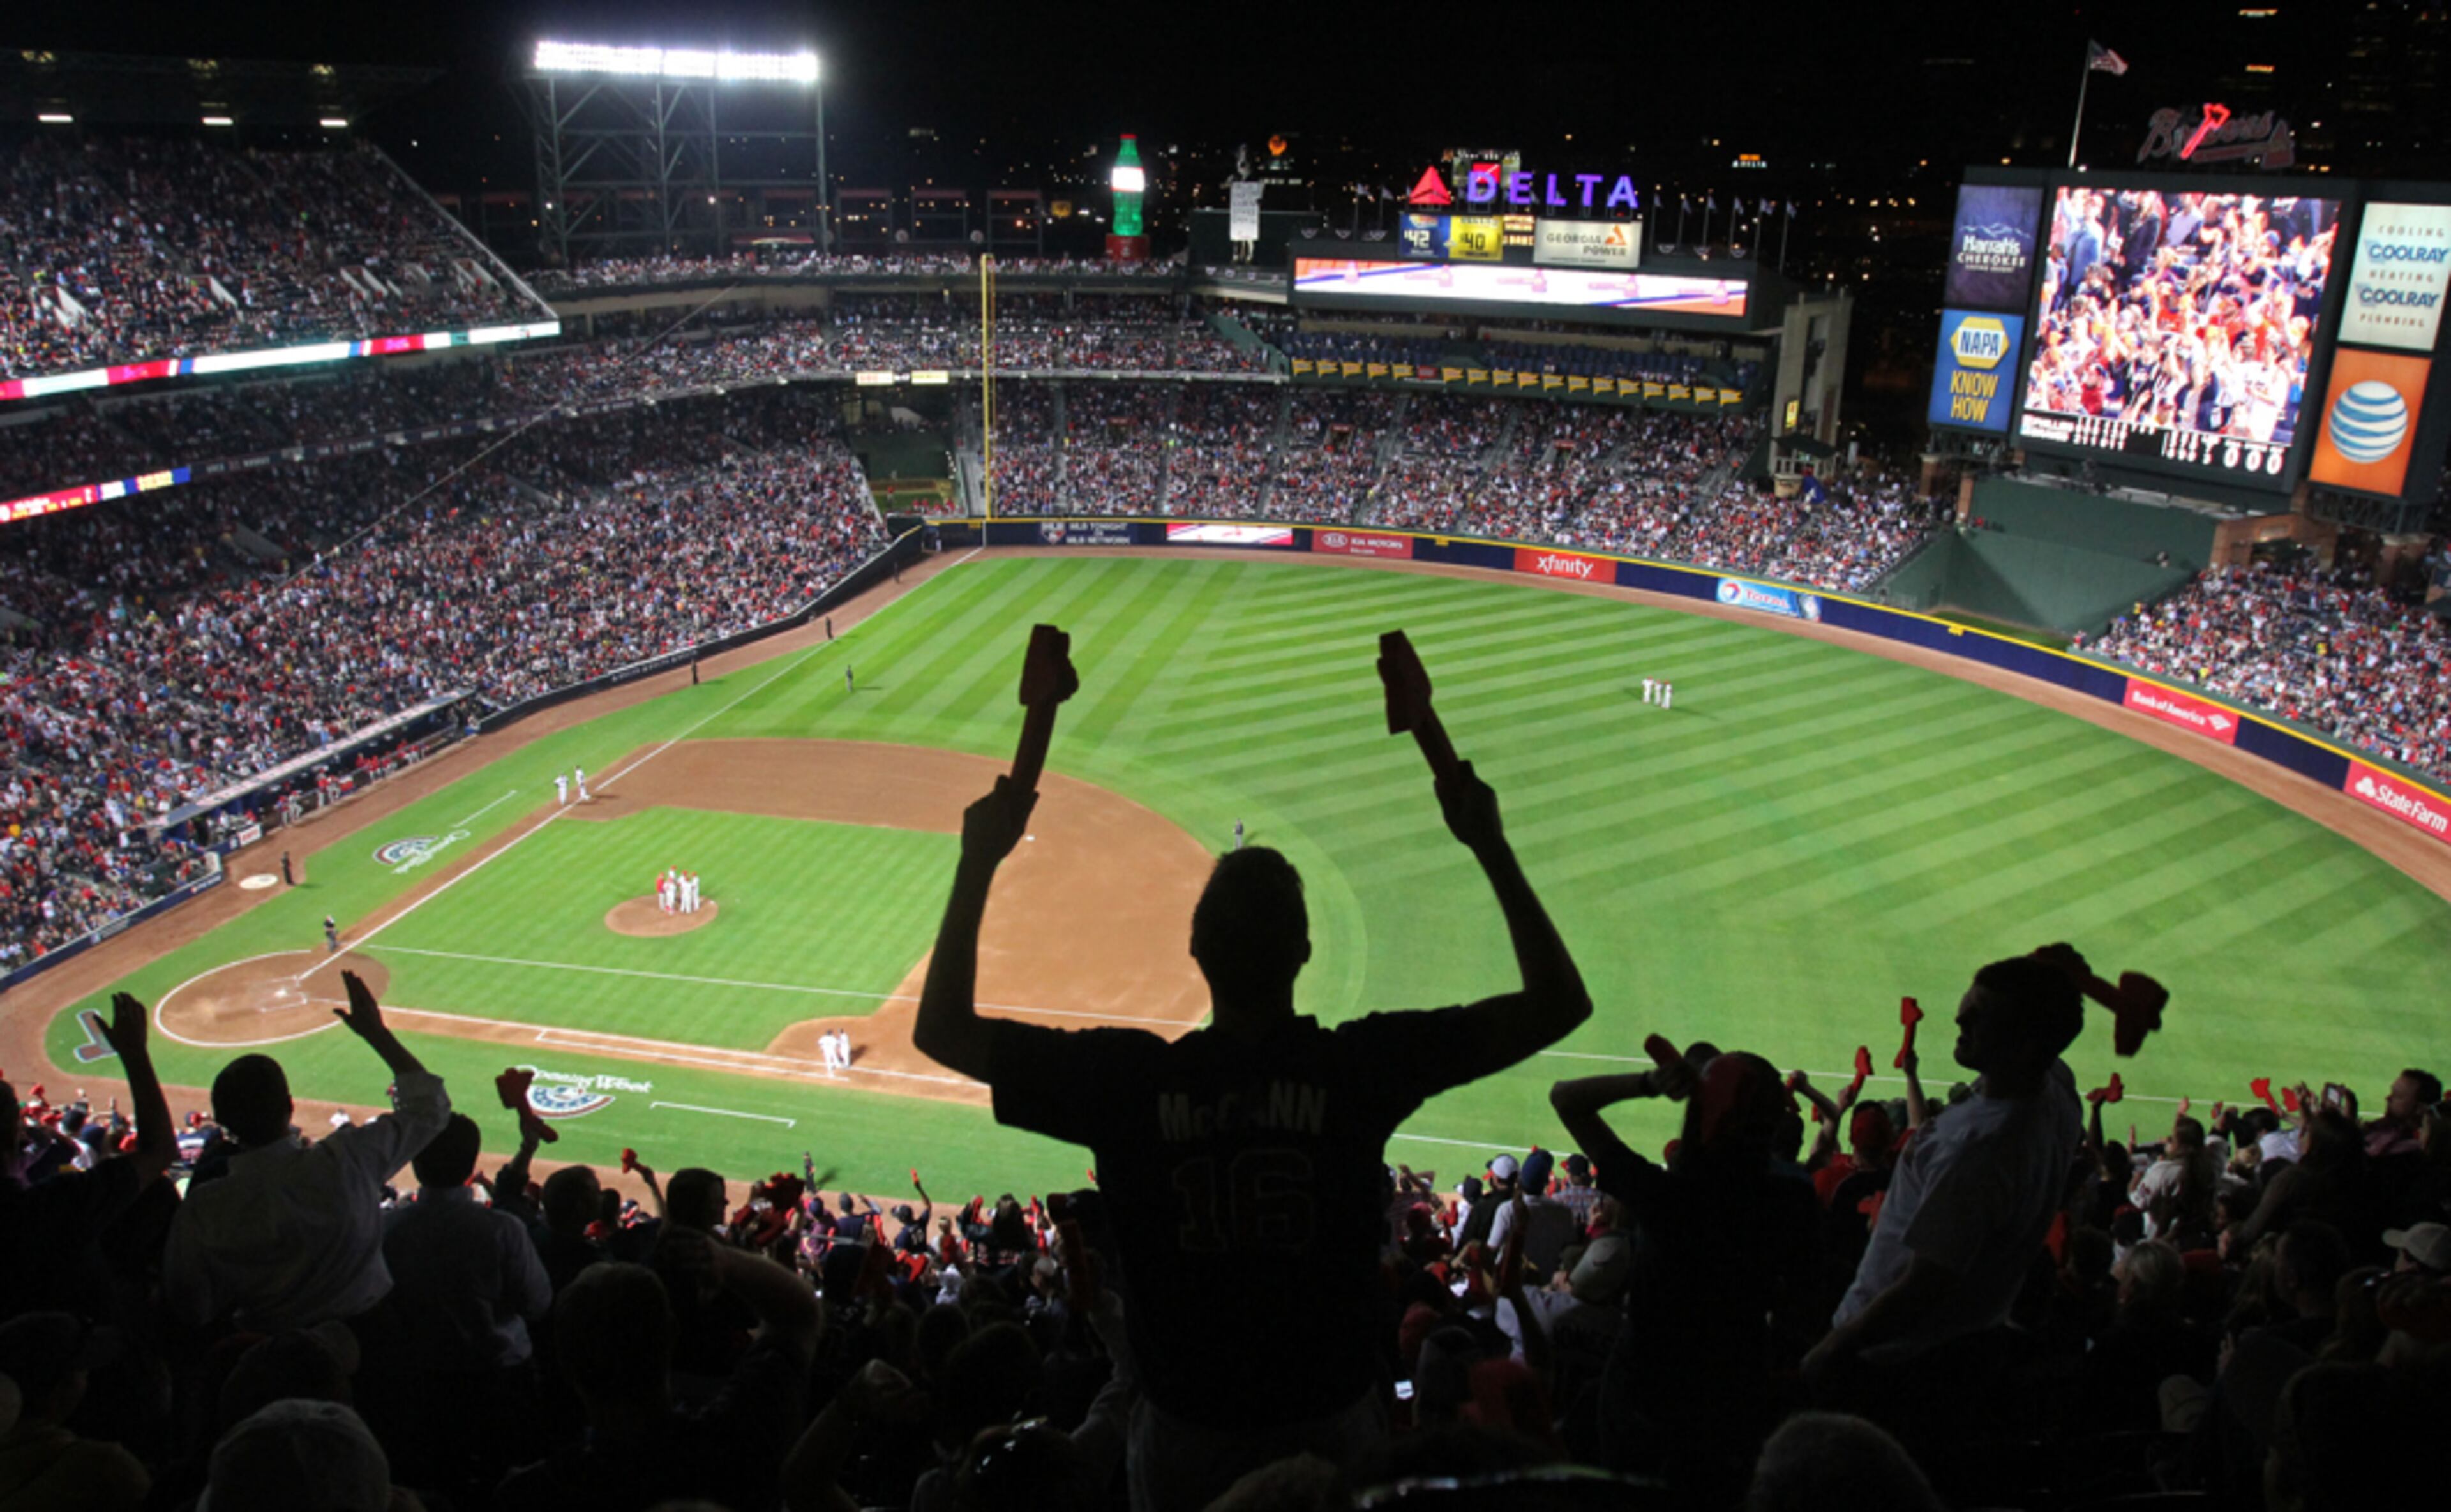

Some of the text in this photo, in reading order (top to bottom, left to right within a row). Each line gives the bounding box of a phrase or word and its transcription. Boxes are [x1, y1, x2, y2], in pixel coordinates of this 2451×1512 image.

[1467, 172, 1638, 208] DELTA
[1584, 245, 1626, 257] POWER
[2369, 243, 2448, 264] COOLRAY
[2359, 287, 2438, 308] COOLRAY
[1960, 330, 2000, 356] NAPA
[1951, 371, 1998, 398] KNOW
[1951, 397, 1989, 423] HOW
[1536, 555, 1593, 578] xfinity
[1746, 589, 1788, 608] TOTAL
[2374, 784, 2448, 833] State Farm
